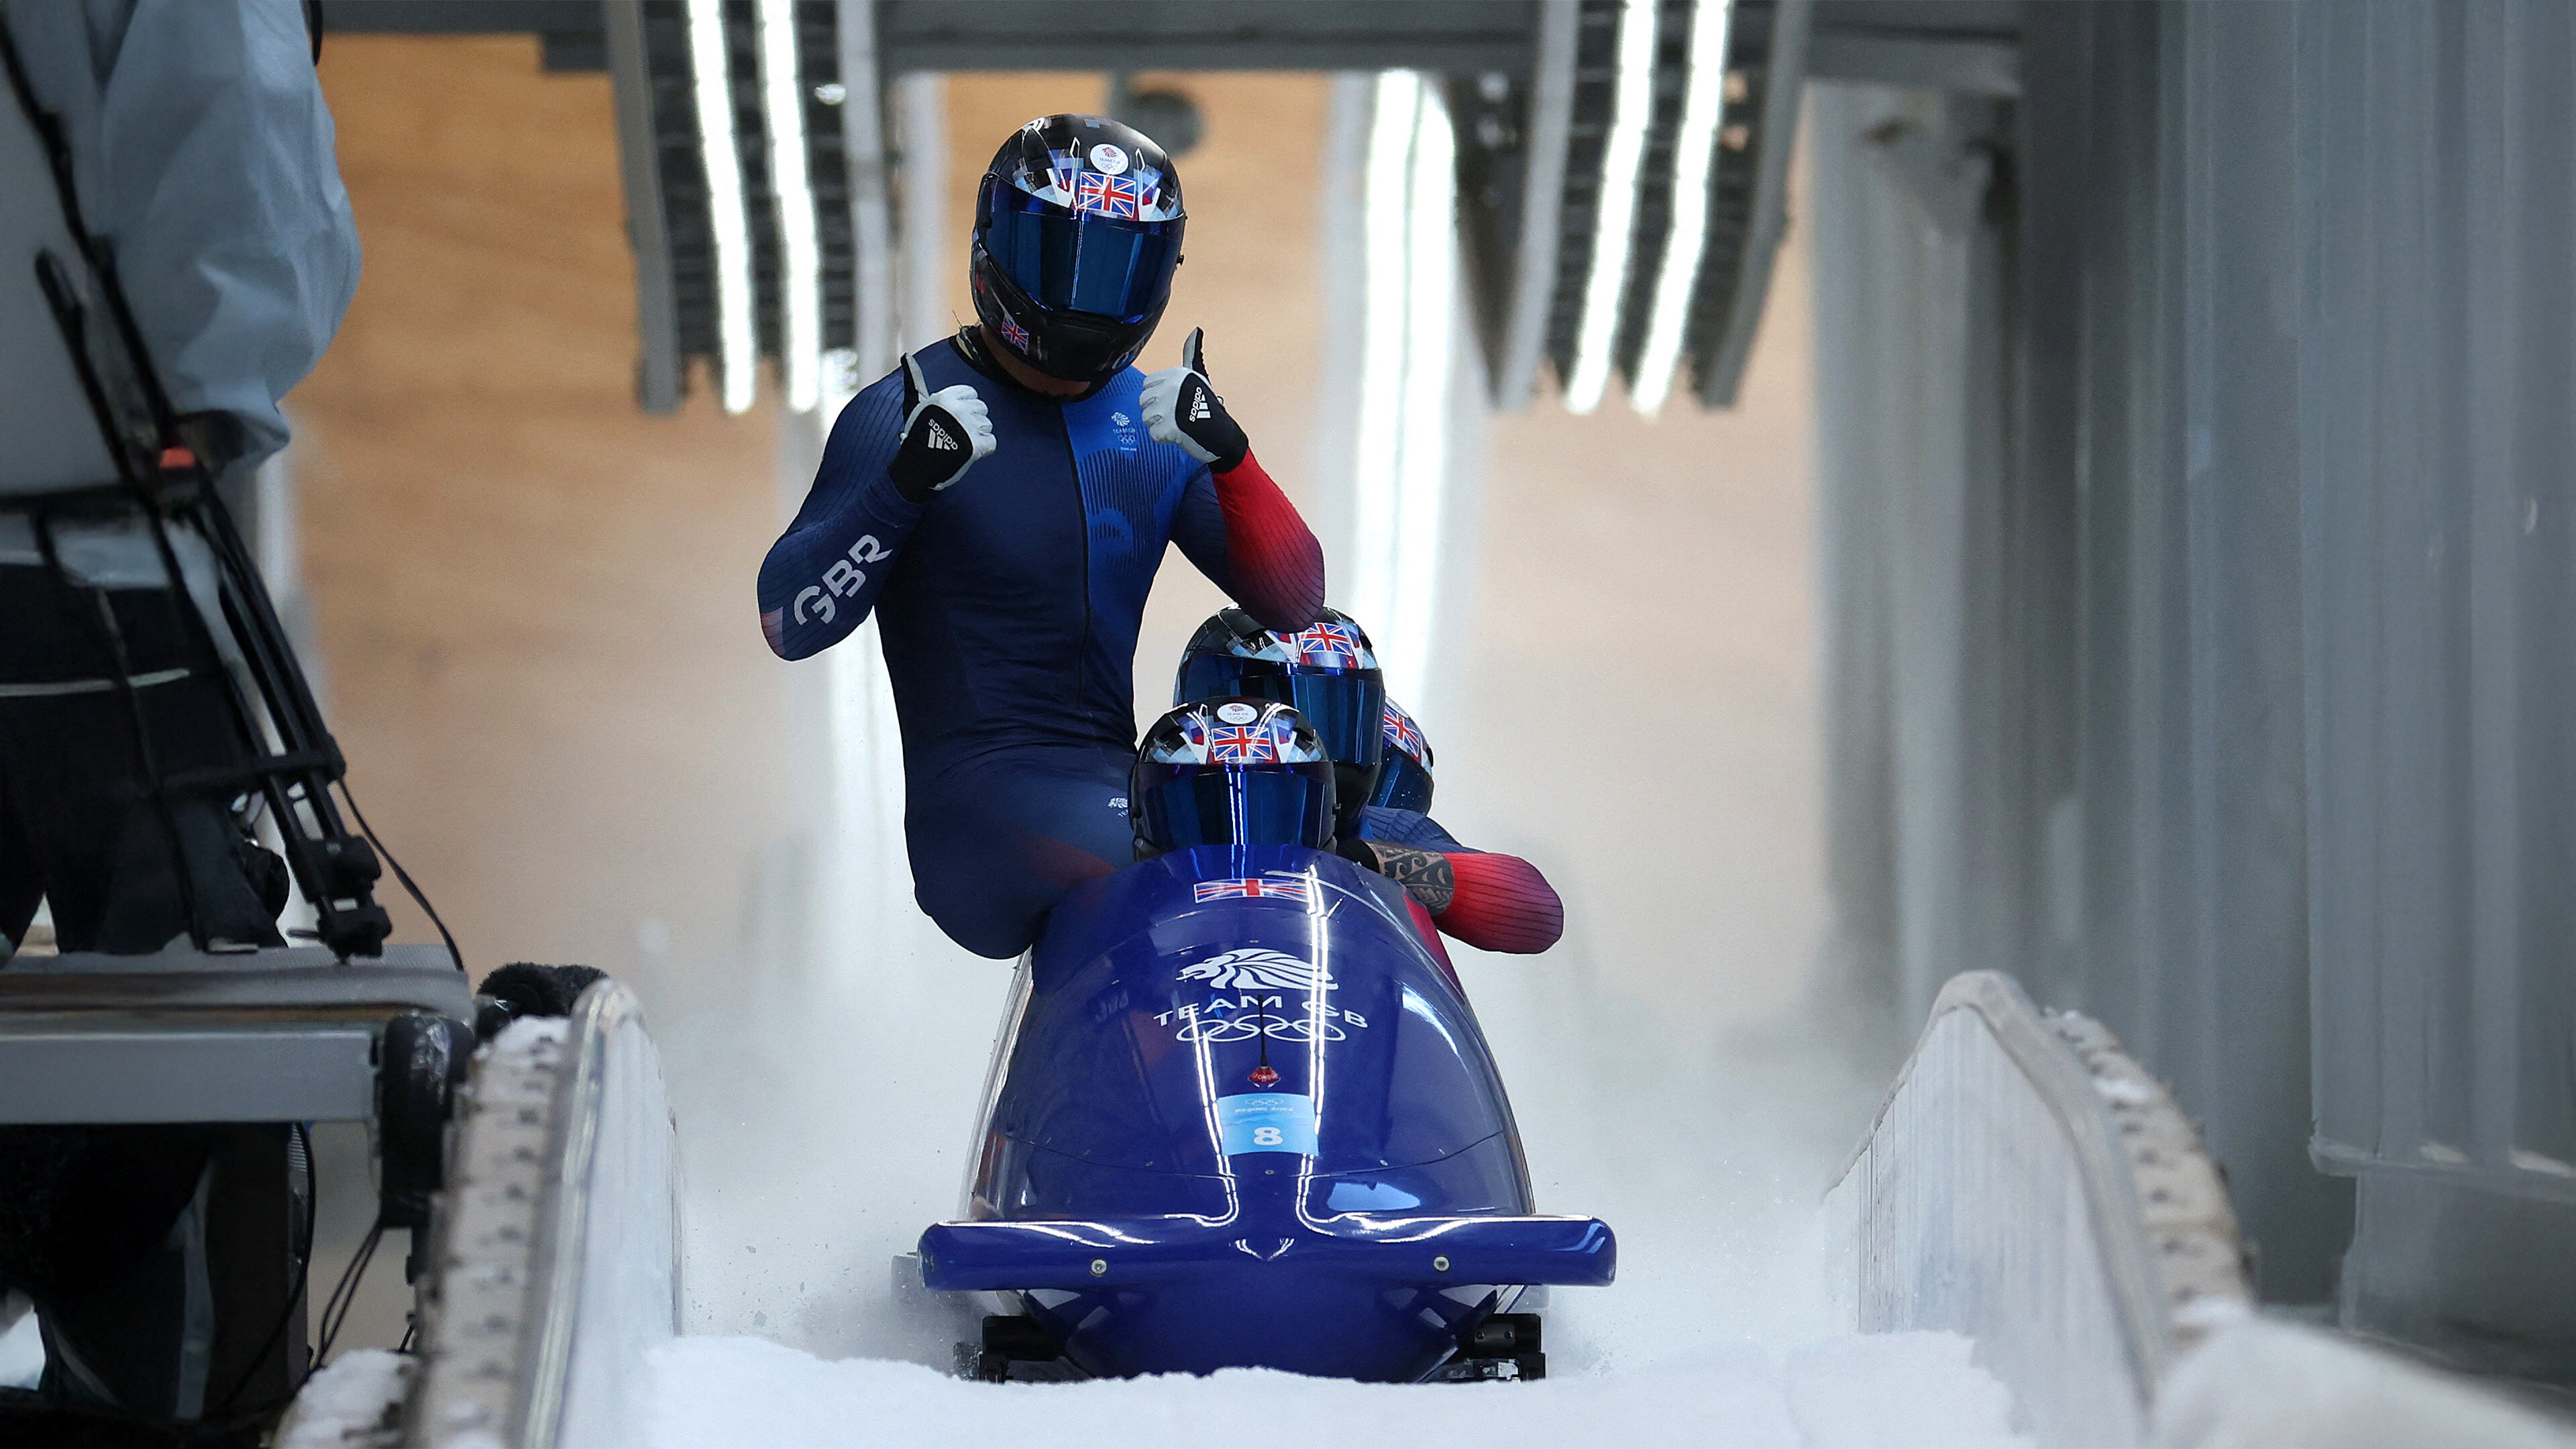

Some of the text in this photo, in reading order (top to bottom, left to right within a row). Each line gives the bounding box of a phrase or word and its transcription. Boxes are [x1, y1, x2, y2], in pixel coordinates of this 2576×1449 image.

[1189, 386, 1202, 422] adidas
[928, 419, 958, 450] adidas
[794, 534, 894, 625] GBR
[1153, 996, 1282, 1026] TEAM
[1253, 1127, 1284, 1146] 8
